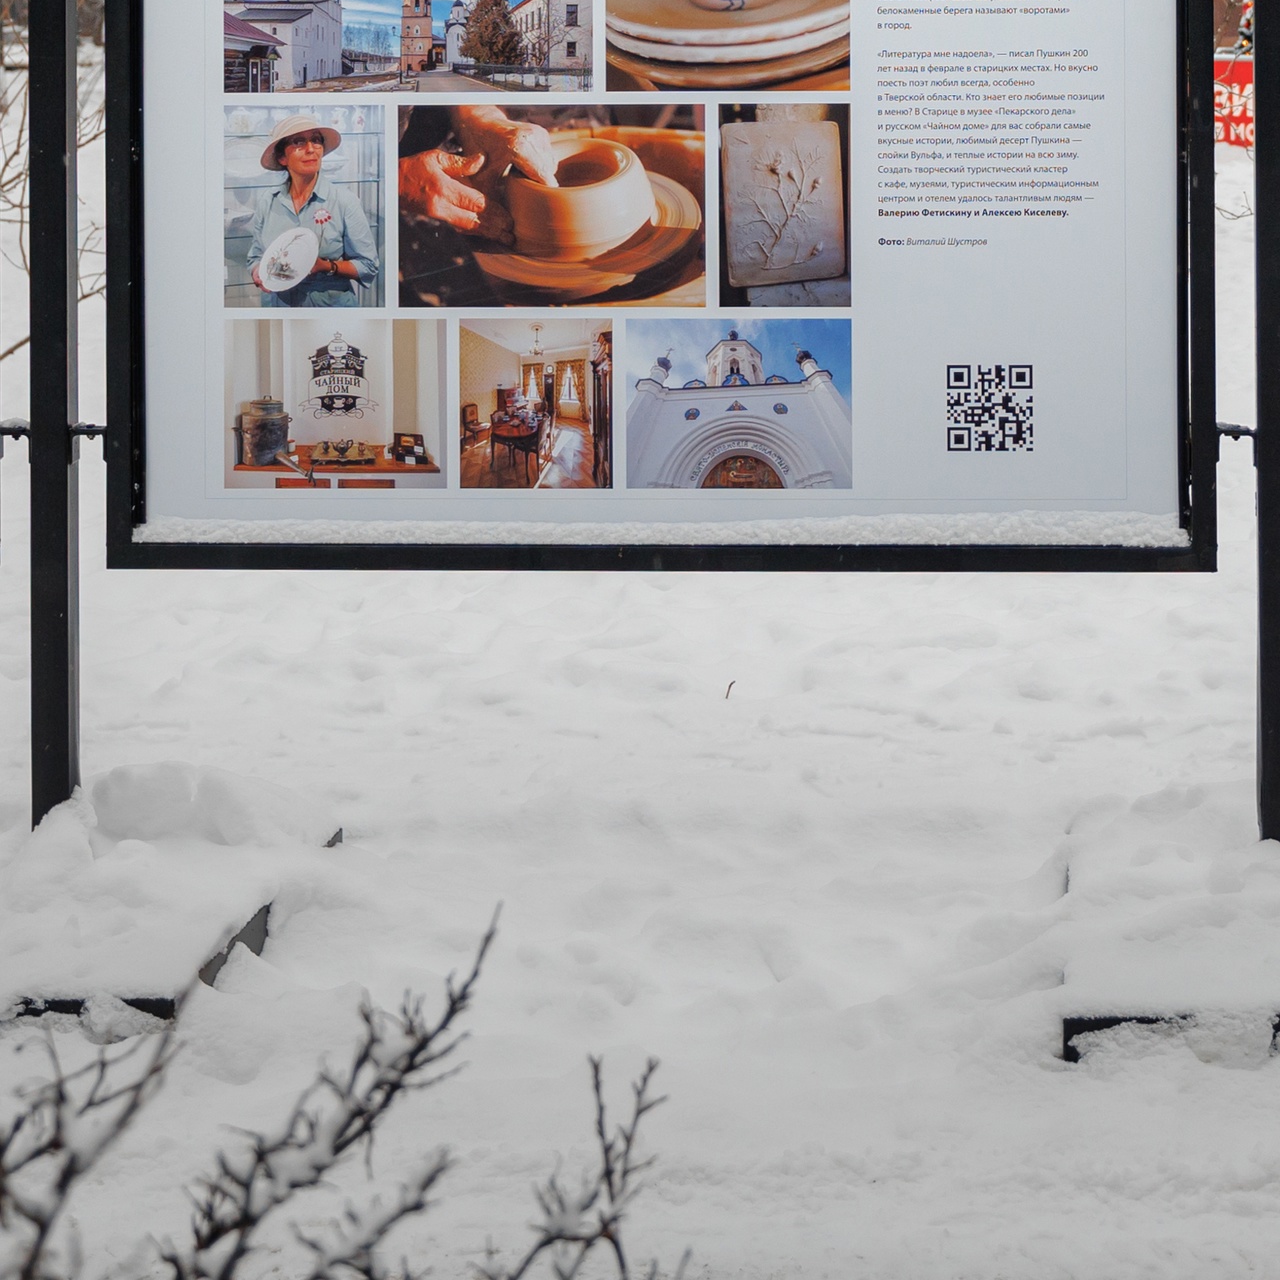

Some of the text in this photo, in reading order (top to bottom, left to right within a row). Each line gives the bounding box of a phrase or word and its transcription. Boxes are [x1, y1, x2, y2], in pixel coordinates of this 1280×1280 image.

[877, 6, 942, 14] белокаменные
[944, 6, 973, 16] берега
[877, 50, 932, 60] «Литература
[1037, 49, 1070, 59] Пушкин
[1073, 49, 1088, 57] 200
[878, 209, 920, 218] Валерию
[922, 209, 972, 218] Фетискину
[1024, 208, 1069, 218] Киселеву.
[948, 238, 987, 247] Шустров
[315, 376, 360, 387] ЧАЙНЫЙ
[326, 385, 349, 394] ДОМ
